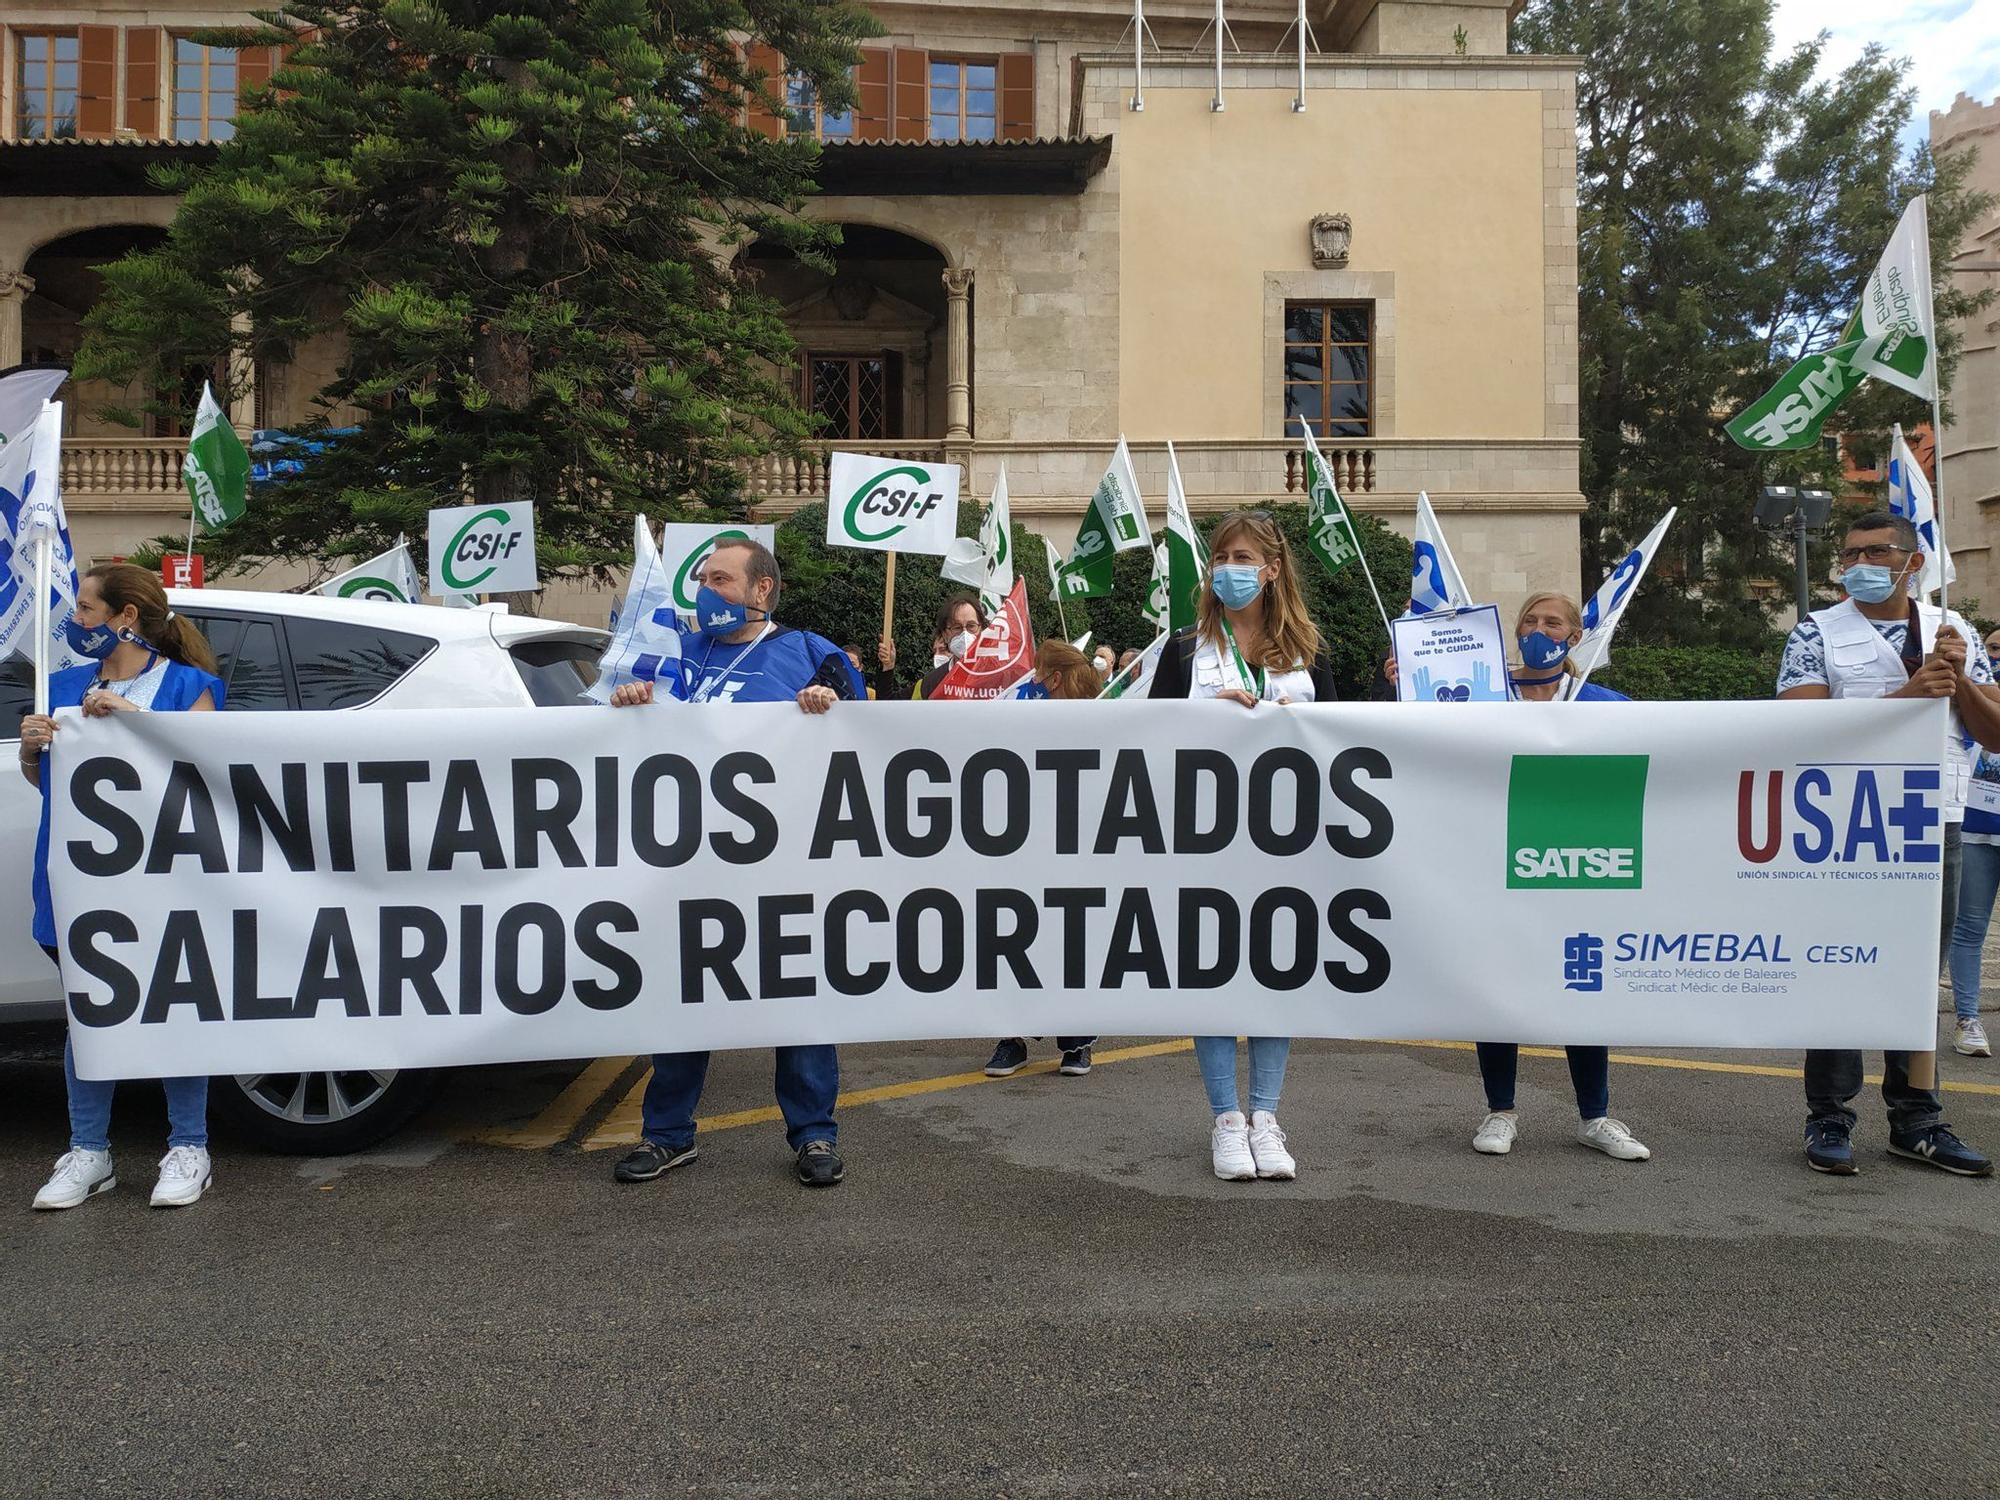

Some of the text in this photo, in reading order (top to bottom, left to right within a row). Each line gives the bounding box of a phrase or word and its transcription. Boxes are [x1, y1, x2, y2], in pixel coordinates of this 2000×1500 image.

[183, 451, 228, 528] SATSE
[1431, 628, 1463, 637] Somos
[1422, 634, 1474, 647] las MANOS
[1413, 642, 1484, 657] que te CUIDAN
[66, 746, 1395, 877] SANITARIOS AGOTADOS
[1513, 847, 1635, 878] SATSE
[1736, 867, 1941, 881] UNIÓN SINDICAL Y TÉCNICOS SANITARIOS
[1613, 932, 1878, 964] SIMEBAL CESM
[67, 886, 1392, 1028] SALARIOS RECORTADOS
[1612, 967, 1797, 980] Sindicato Médico de Baleares
[1627, 981, 1678, 993] Sindicat
[1721, 981, 1739, 993] de
[1741, 981, 1788, 993] Balears
